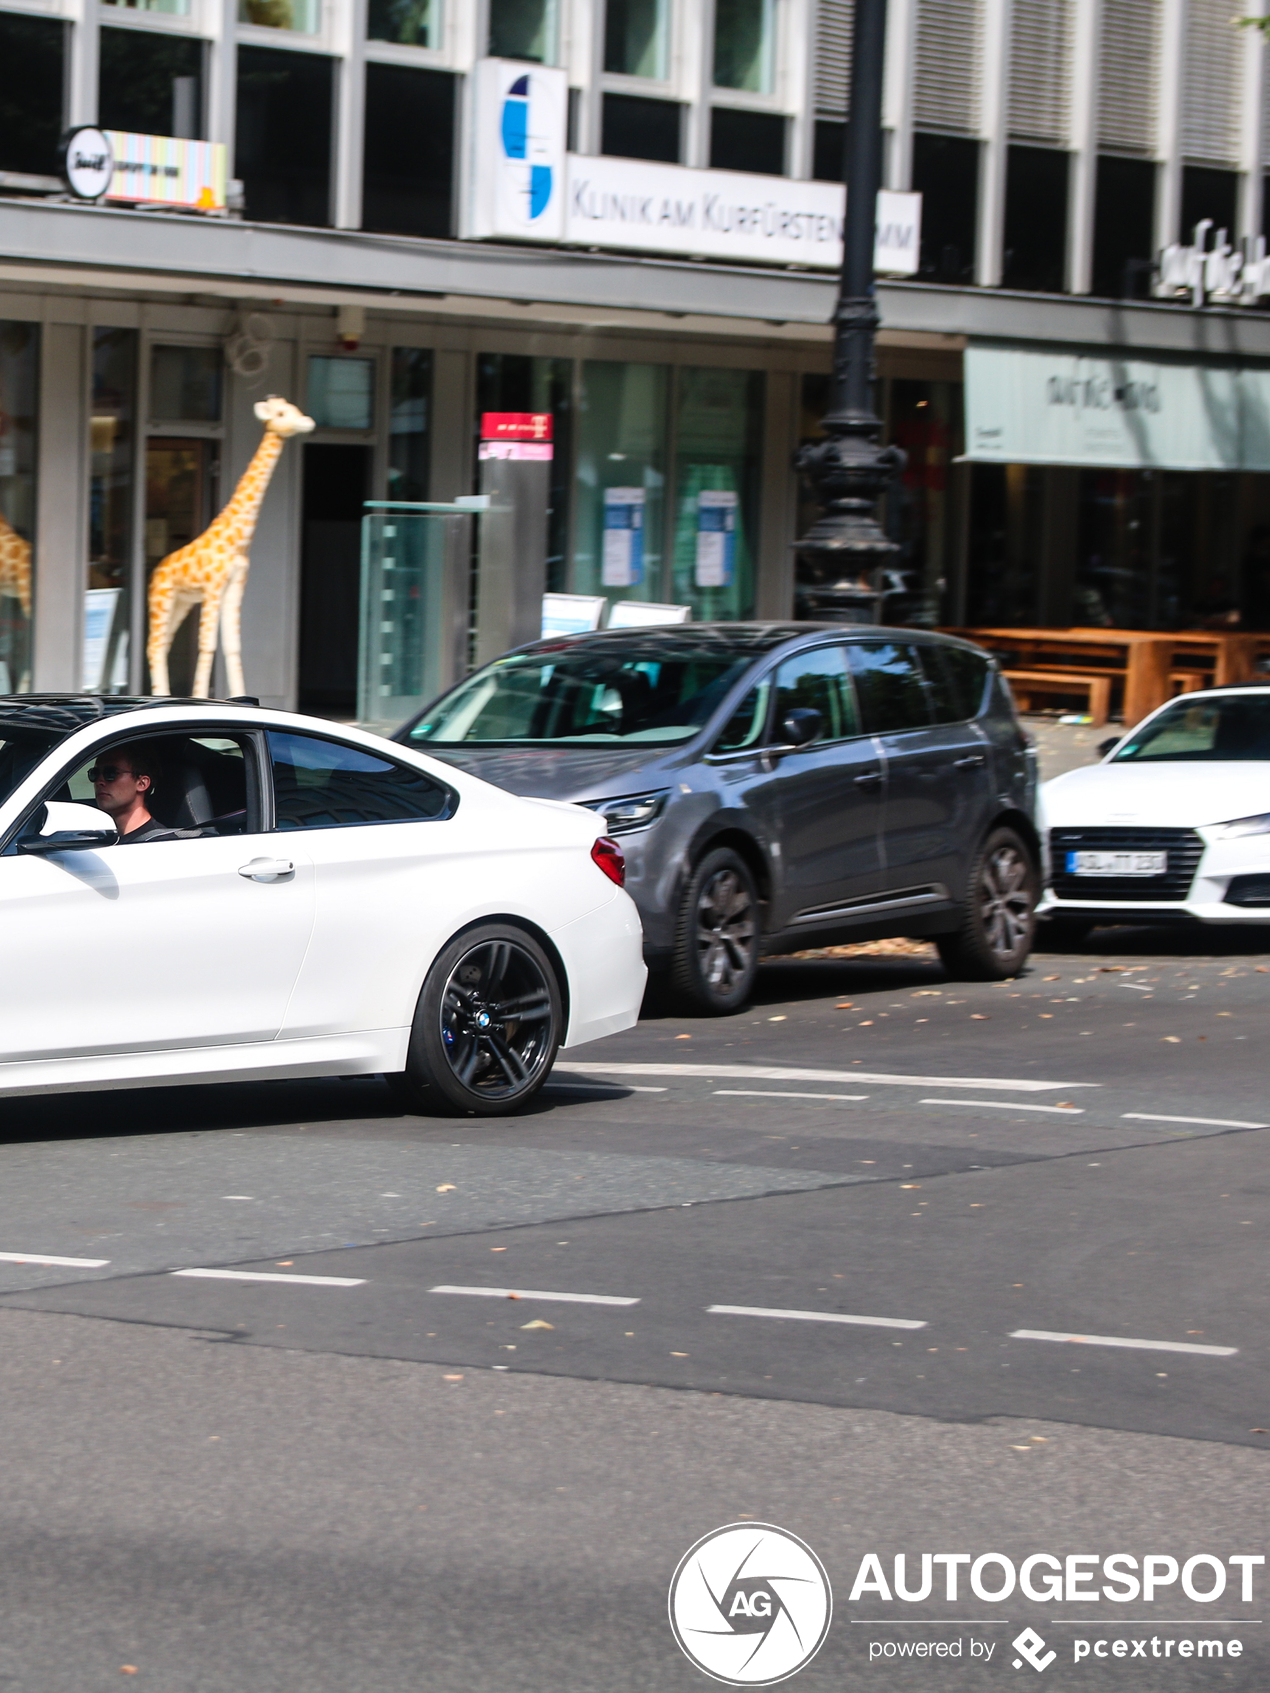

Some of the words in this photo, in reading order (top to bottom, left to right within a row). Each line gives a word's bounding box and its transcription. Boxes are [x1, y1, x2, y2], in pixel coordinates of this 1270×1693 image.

[572, 179, 654, 224] KLINIK
[657, 198, 696, 228] AM
[701, 192, 914, 249] KURFÜRSTENMM
